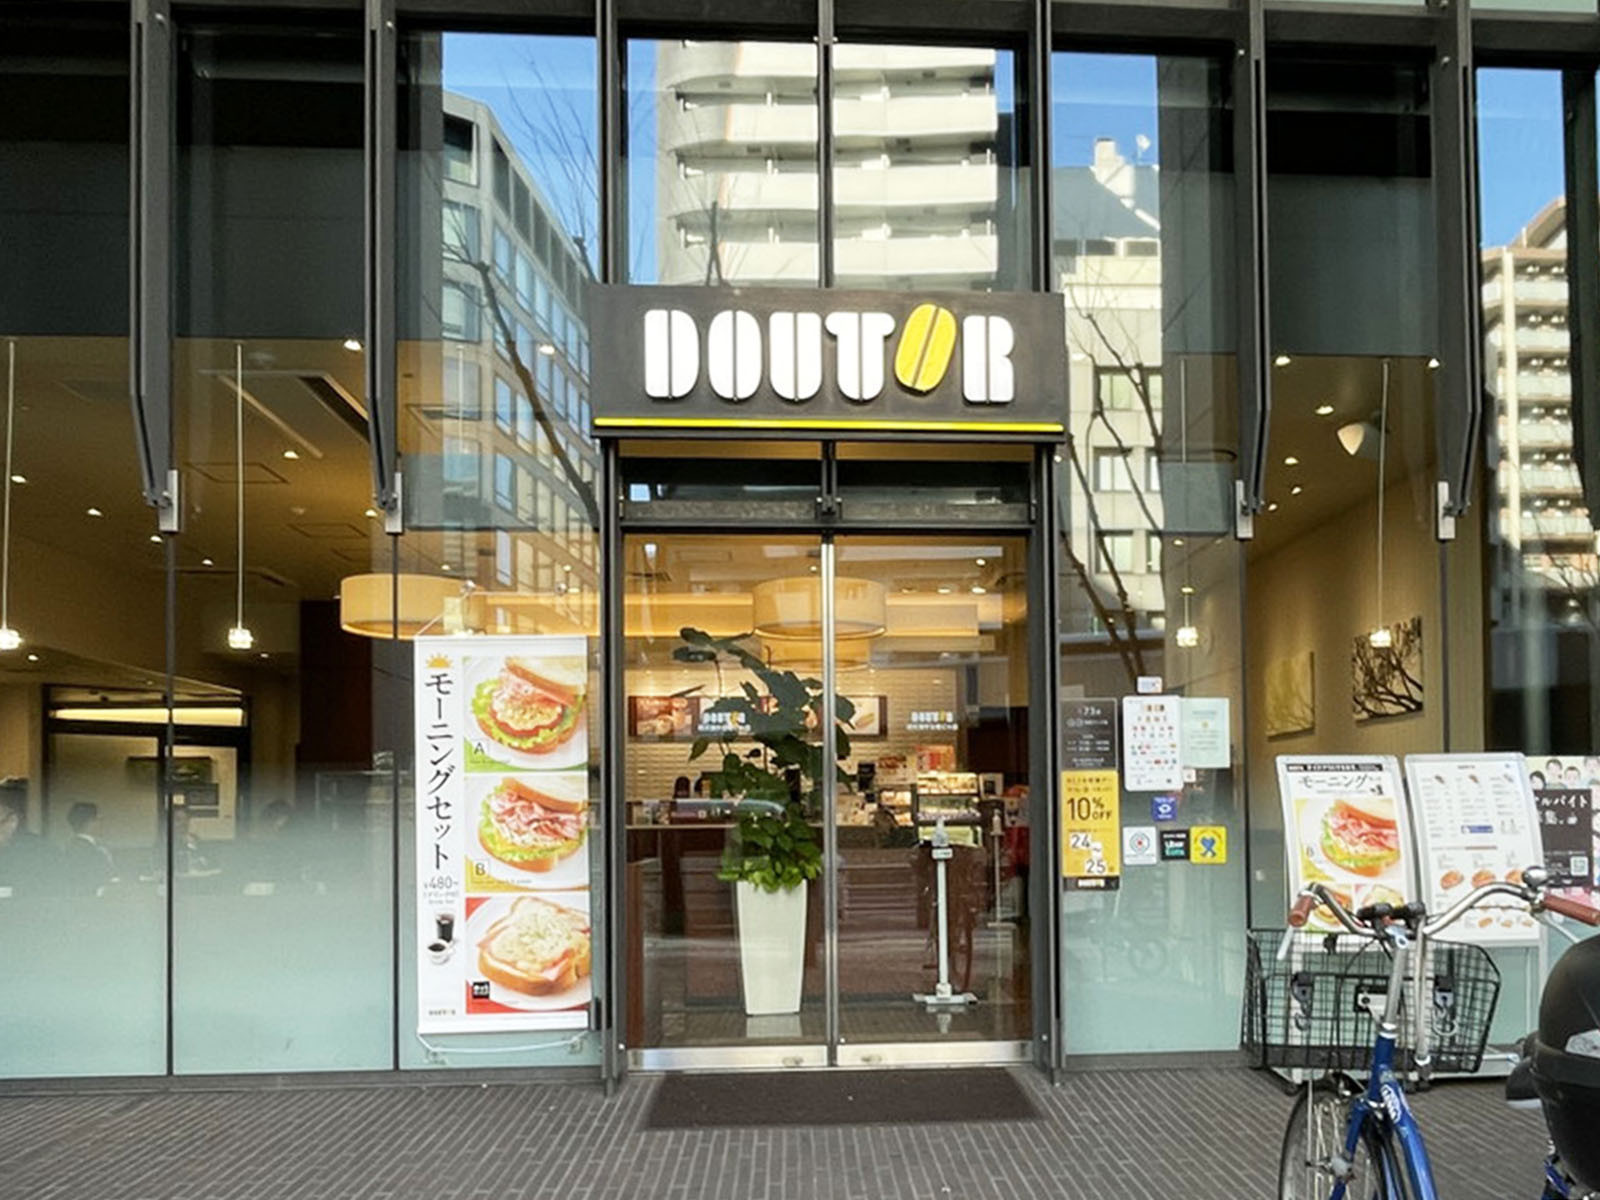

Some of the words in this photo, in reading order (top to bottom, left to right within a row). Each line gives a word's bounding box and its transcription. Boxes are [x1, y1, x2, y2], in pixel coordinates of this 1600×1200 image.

[644, 303, 1015, 404] DOUTOR
[473, 741, 485, 755] A
[424, 672, 456, 870] モーニングセット
[474, 862, 487, 876] B
[1086, 858, 1106, 874] 25
